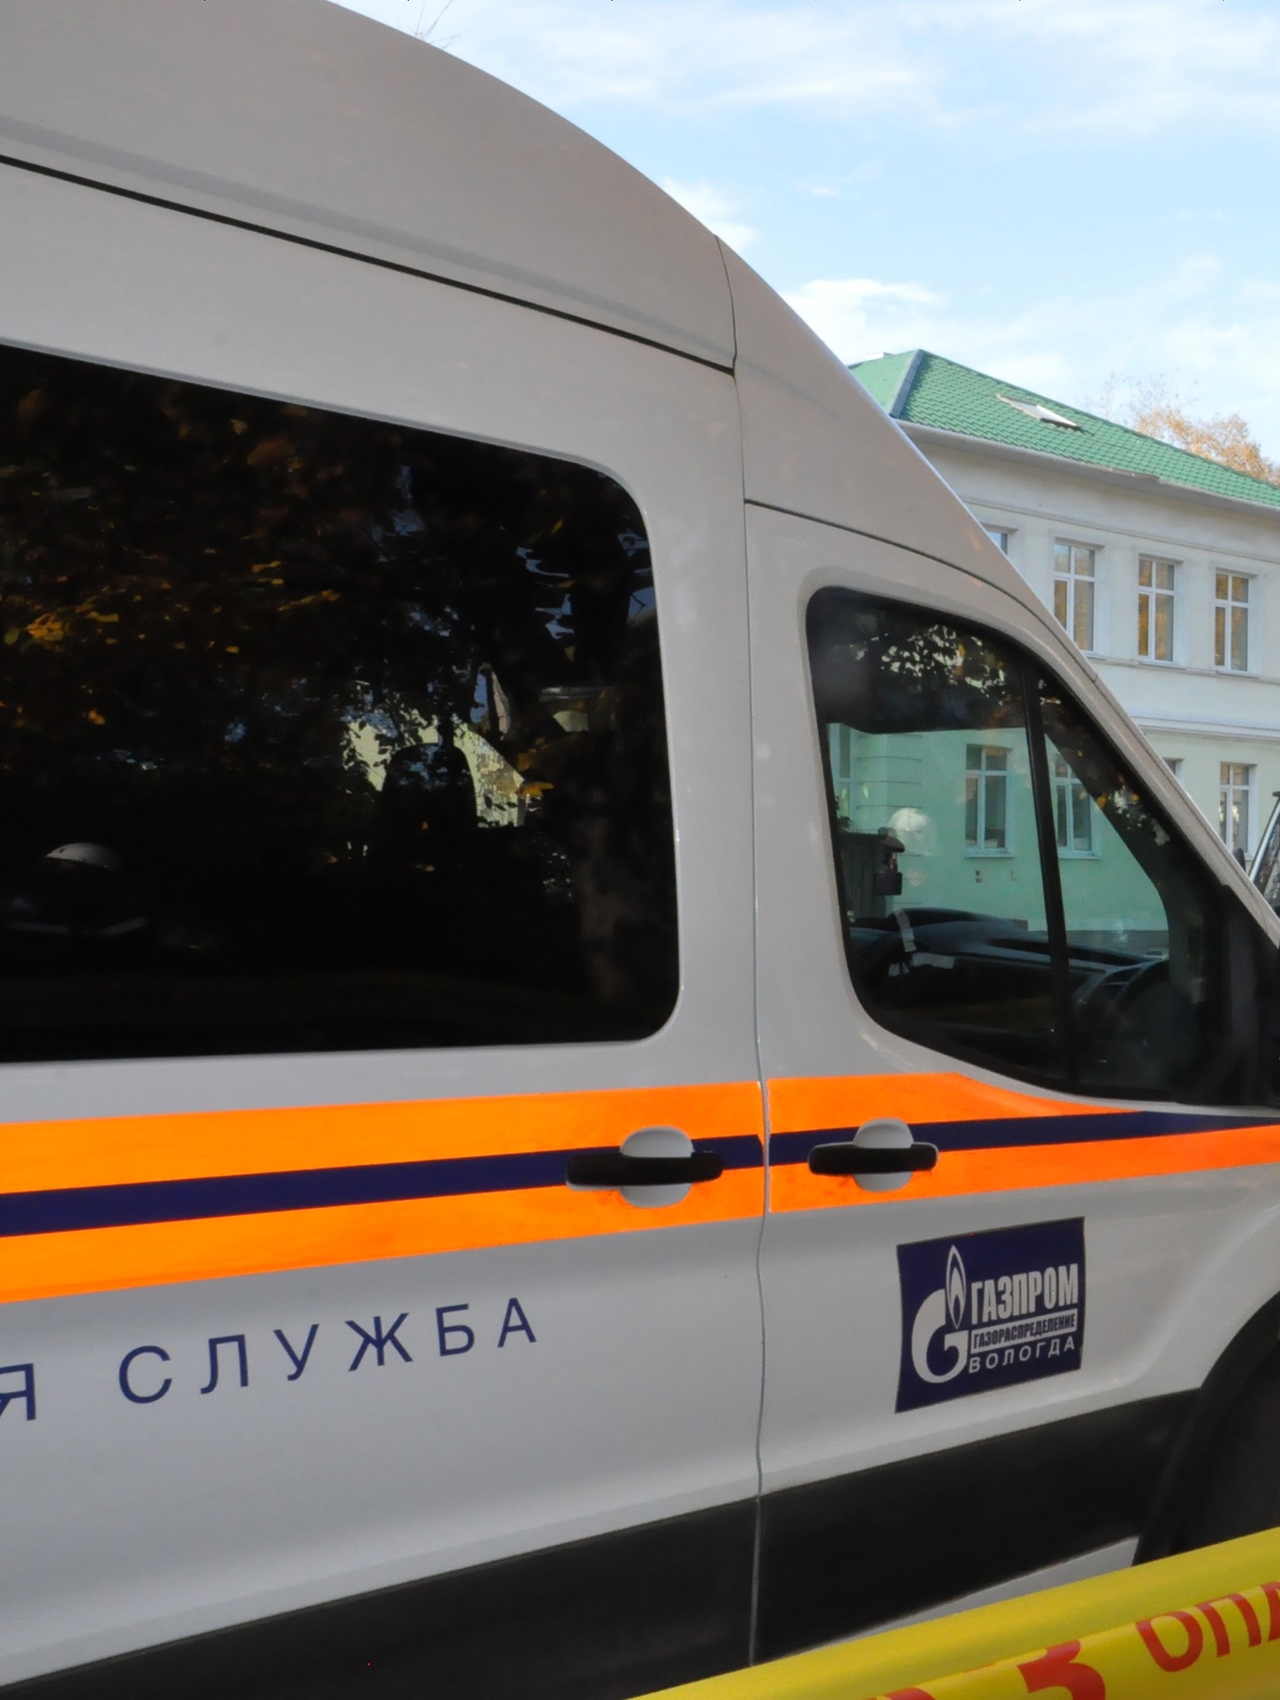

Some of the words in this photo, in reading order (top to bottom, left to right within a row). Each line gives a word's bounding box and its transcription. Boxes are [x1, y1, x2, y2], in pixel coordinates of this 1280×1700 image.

[970, 1263, 1079, 1325] ГАЗПРОМ
[118, 1297, 537, 1404] СЛУЖБА
[968, 1336, 1076, 1374] ВОЛОГДА
[973, 1312, 1076, 1349] ГАЗОРАСПРЕДЕЛЕНИЕ
